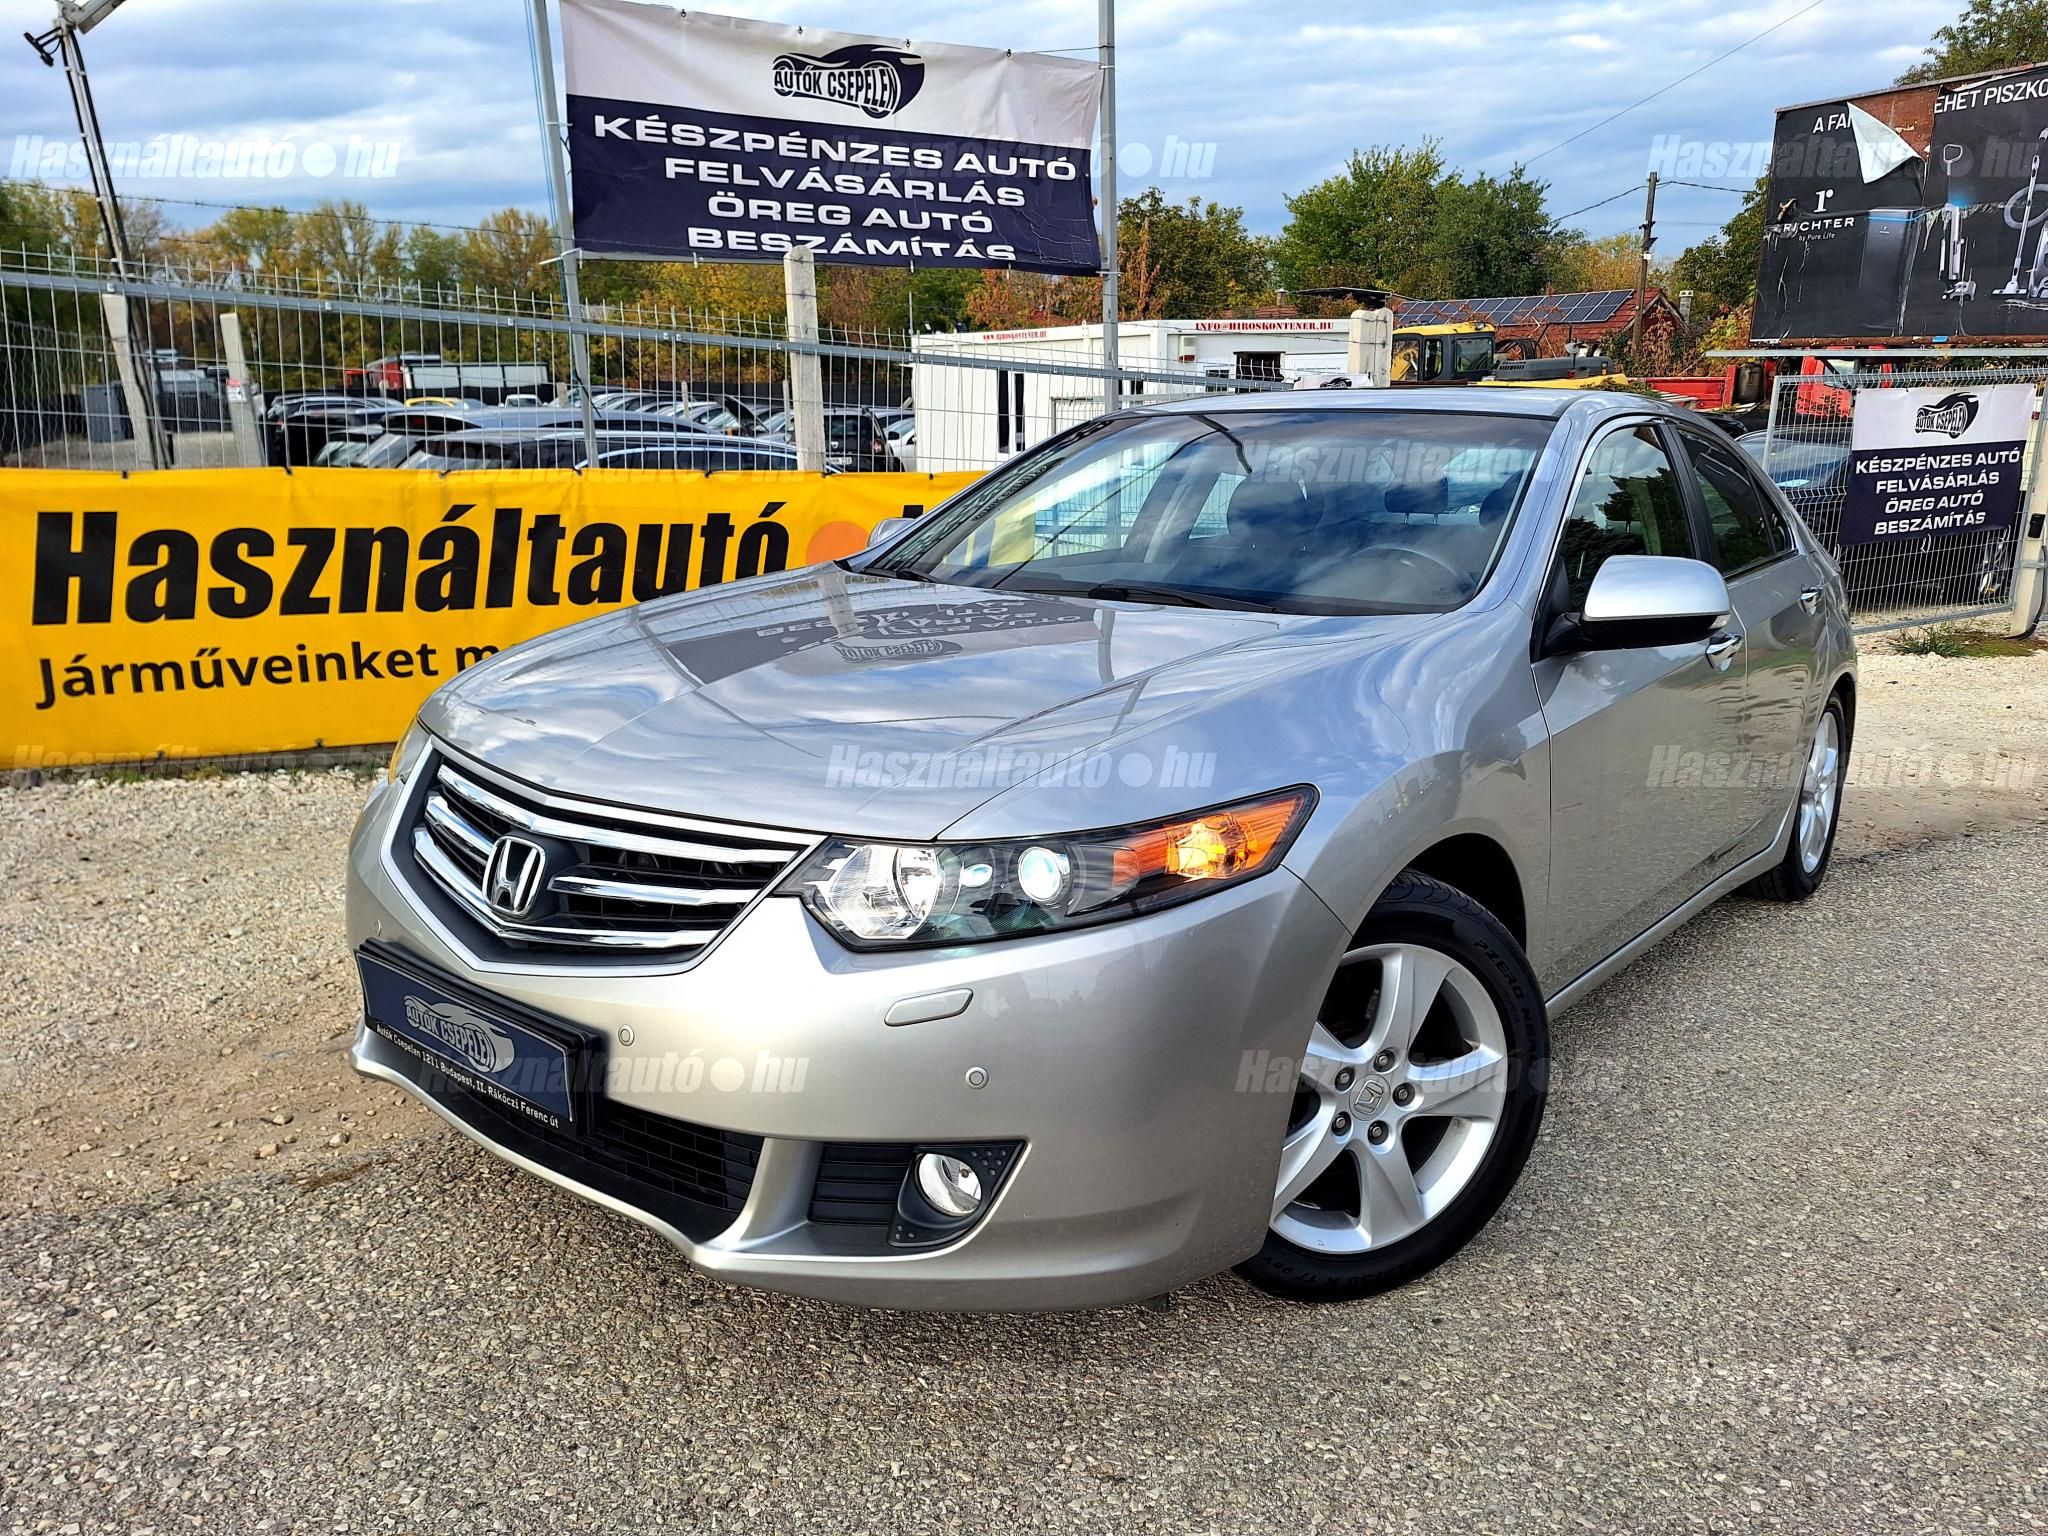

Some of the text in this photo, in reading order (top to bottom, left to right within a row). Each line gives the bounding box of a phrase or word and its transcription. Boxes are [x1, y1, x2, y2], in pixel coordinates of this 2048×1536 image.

[828, 67, 897, 110] CSEPELEN
[1812, 117, 1824, 133] A
[594, 115, 1076, 181] KÉSZPÉNZES AUTÓ
[664, 157, 1025, 207] FELVÁSÁRLÁS
[708, 190, 993, 233] ÖREG AUTÓ
[687, 227, 1016, 260] BESZÁMÍTÁS
[1855, 447, 2020, 474] KÉSZPÉNZES AUTÓ
[1876, 469, 2000, 494] FELVÁSÁRLÁS
[1874, 511, 1986, 535] BESZÁMÍTÁS
[1885, 491, 1984, 514] ÖREG AUTÓ
[32, 502, 789, 625] Használtautó
[36, 642, 438, 709] Járműveinket
[440, 1021, 495, 1068] CSEPELEN
[422, 1051, 439, 1068] 1211
[488, 1086, 519, 1109] Rákóczi
[521, 1102, 549, 1122] Ferenc
[550, 1115, 559, 1128] út
